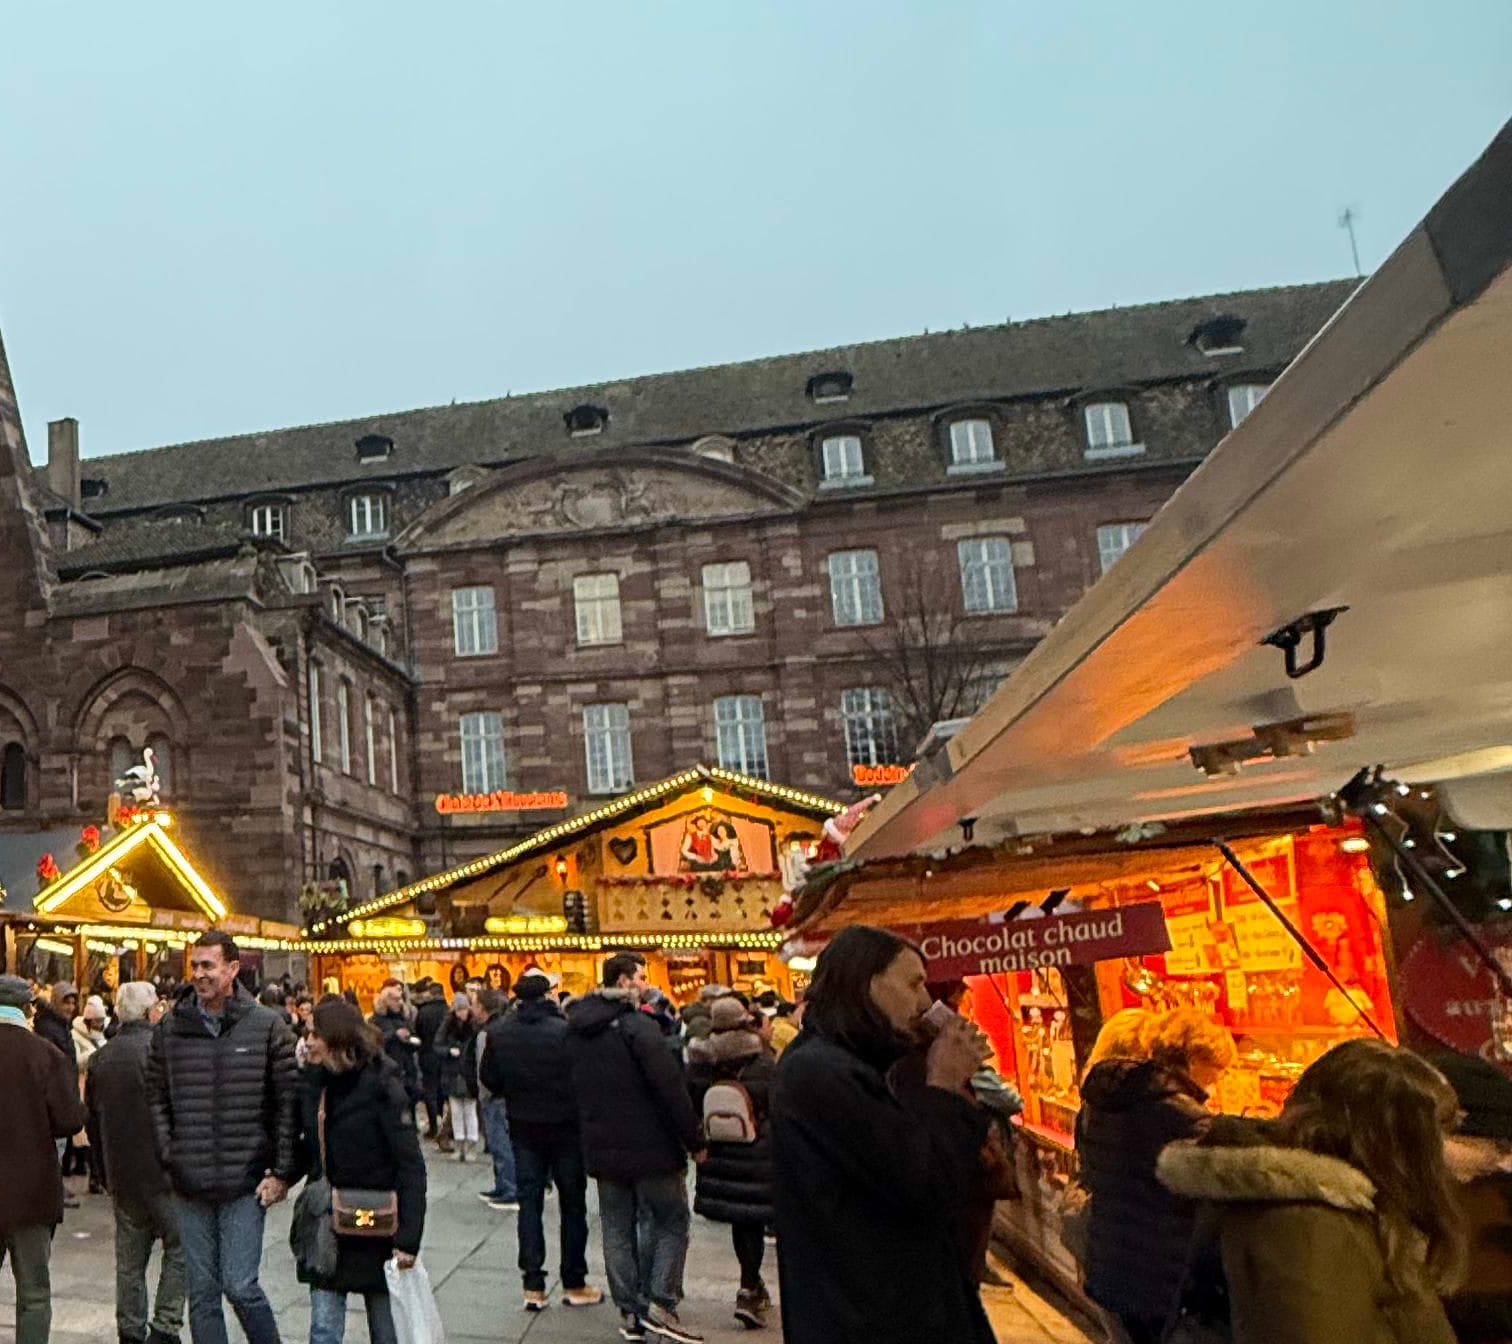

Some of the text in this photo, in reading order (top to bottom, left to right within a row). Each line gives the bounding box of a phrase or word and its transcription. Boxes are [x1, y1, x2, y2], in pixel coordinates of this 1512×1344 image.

[920, 912, 1124, 960] Chocolat chaud
[979, 946, 1072, 975] maison
